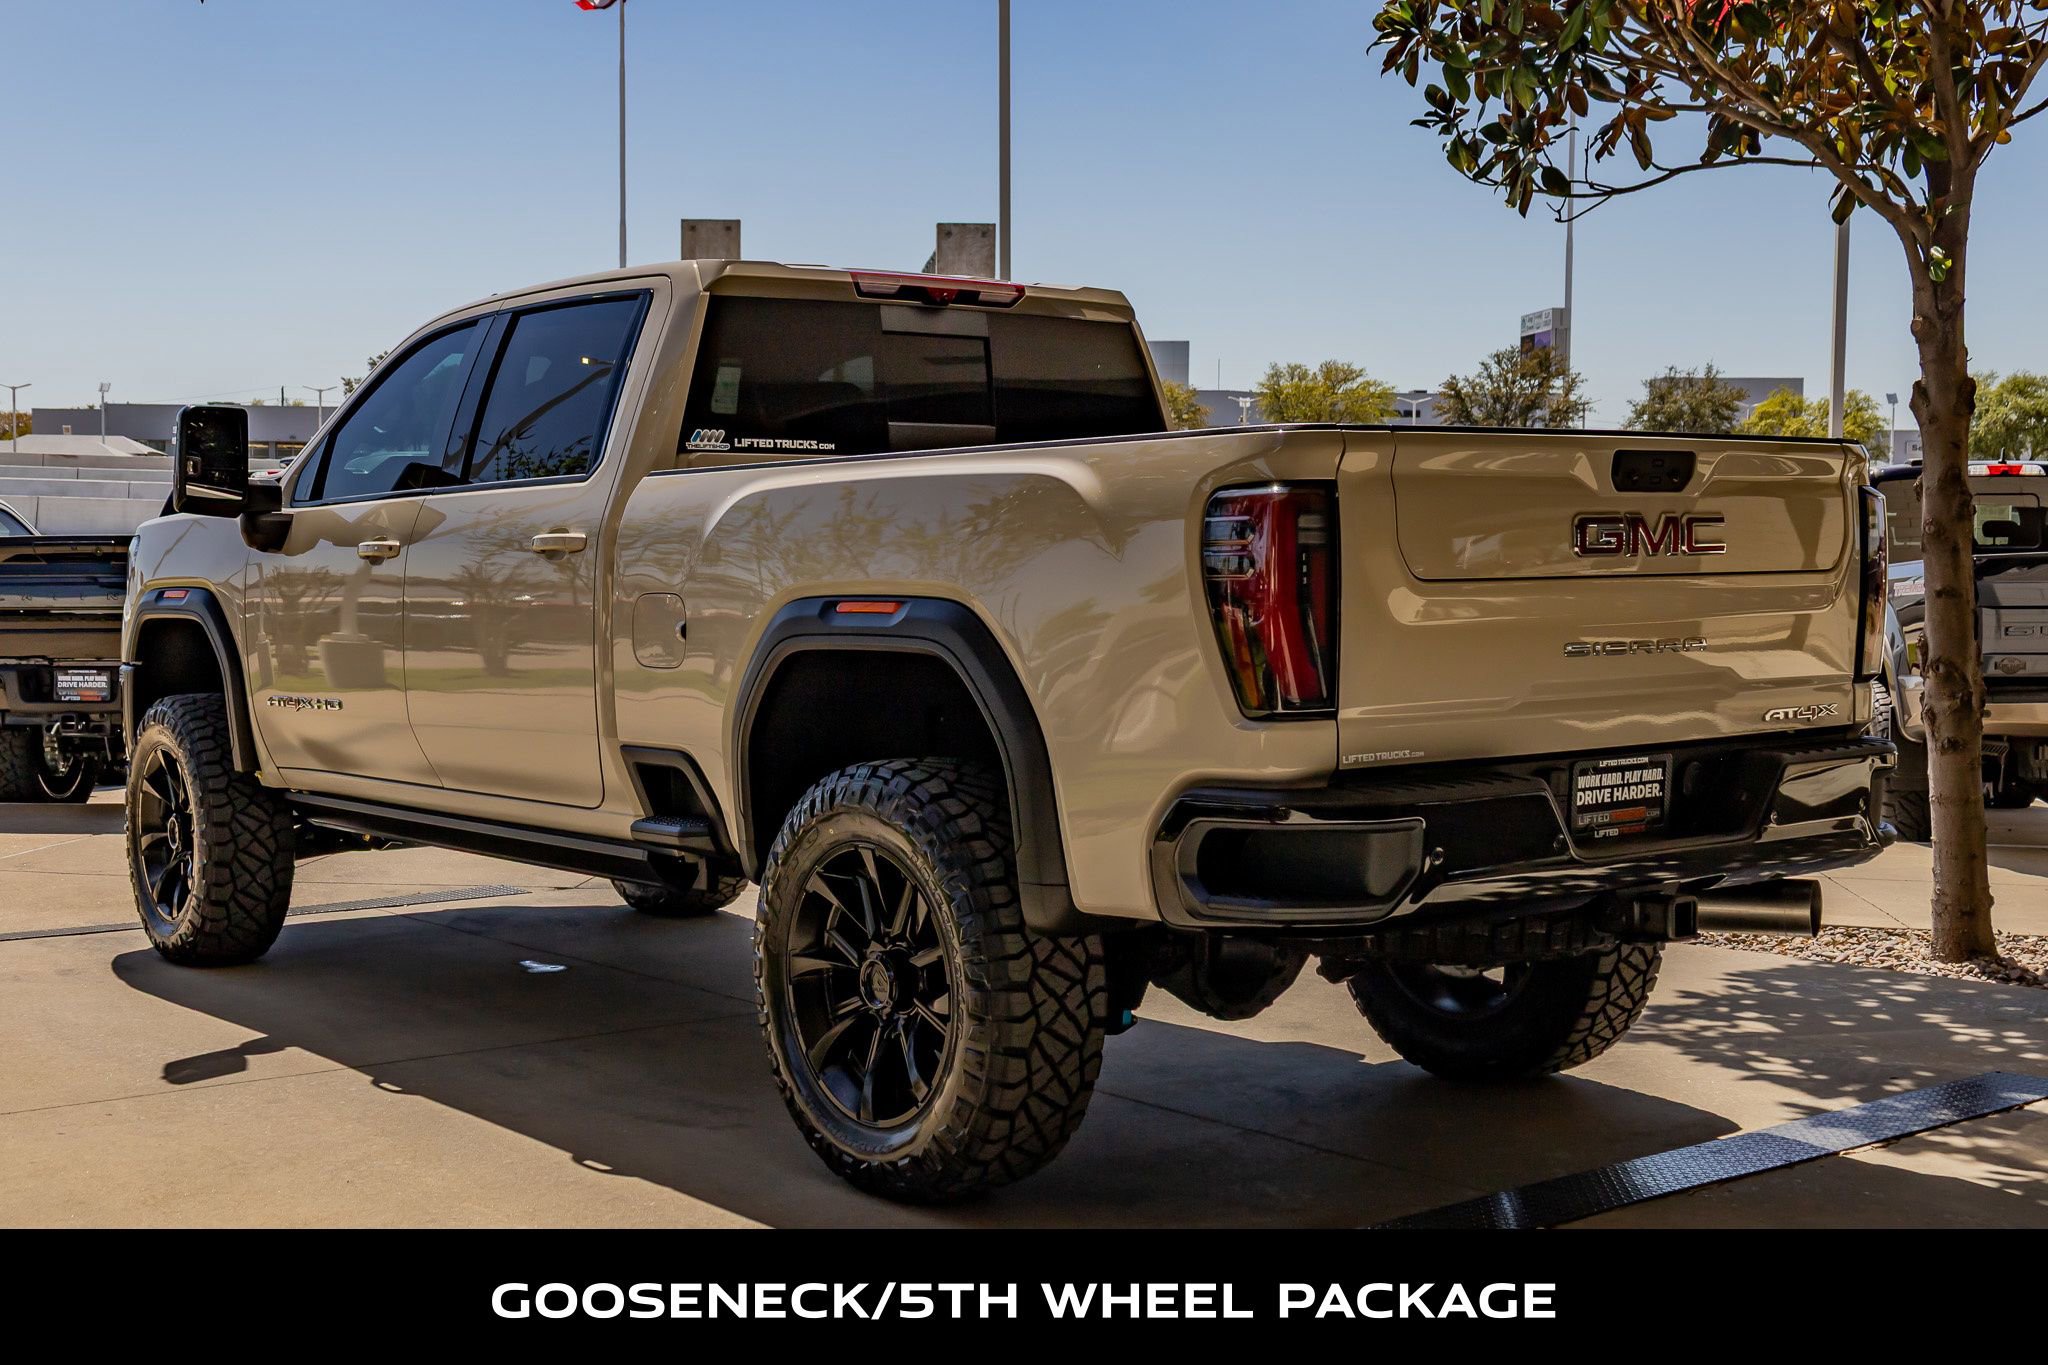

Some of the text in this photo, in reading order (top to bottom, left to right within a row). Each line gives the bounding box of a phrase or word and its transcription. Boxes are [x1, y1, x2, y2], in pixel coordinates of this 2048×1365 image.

[734, 438, 774, 448] LIFTED
[1572, 511, 1727, 557] GMC
[1563, 636, 1708, 657] SIERRA
[1762, 703, 1839, 722] AT4X
[1342, 753, 1375, 764] LIFTED
[1577, 768, 1664, 789] WORK HARD. PLAY HARD.
[1576, 783, 1663, 806] DRIVE HARDER.
[1578, 813, 1610, 825] LIFTED
[1594, 828, 1619, 838] LIFTED
